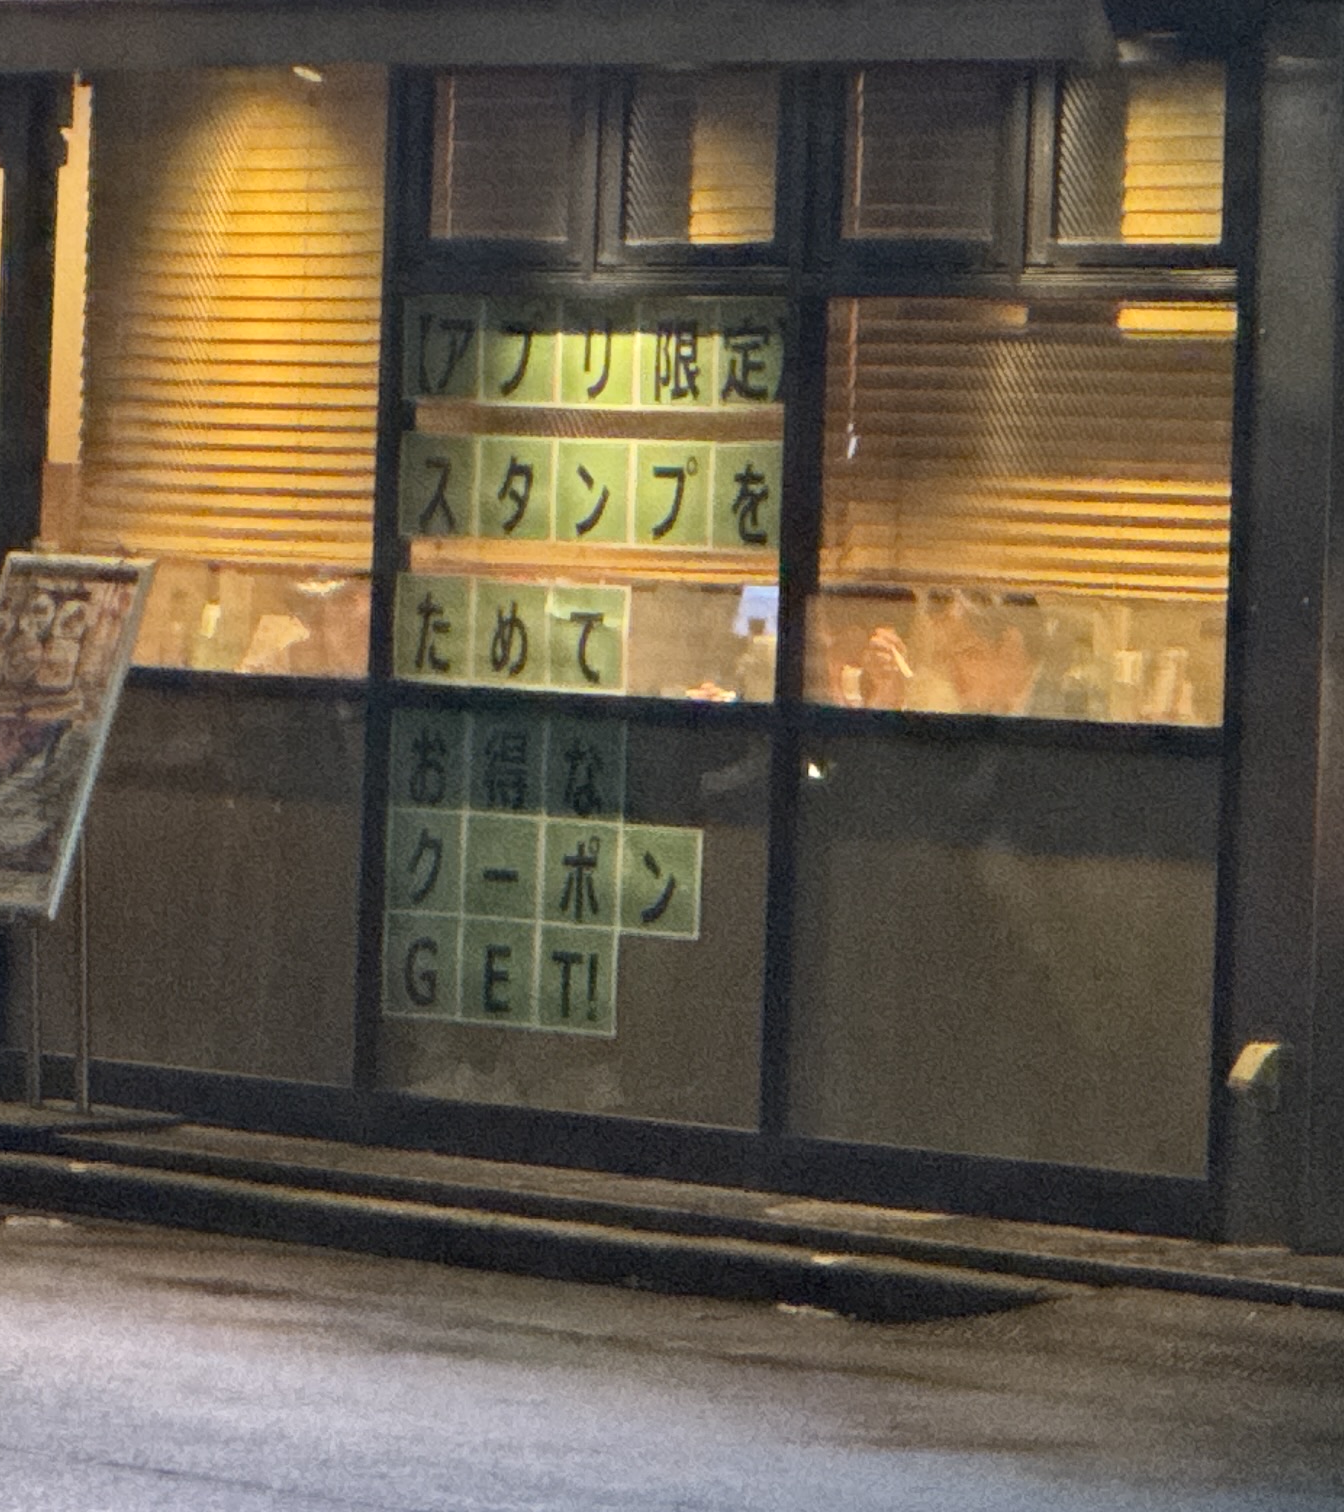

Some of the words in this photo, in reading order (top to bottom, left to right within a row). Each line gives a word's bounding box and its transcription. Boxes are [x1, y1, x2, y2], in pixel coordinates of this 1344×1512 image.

[418, 454, 770, 546] スタンプを
[414, 591, 605, 683] ためて
[408, 728, 605, 818] お得な
[407, 827, 677, 926] クーポン
[403, 937, 600, 1023] GET!
